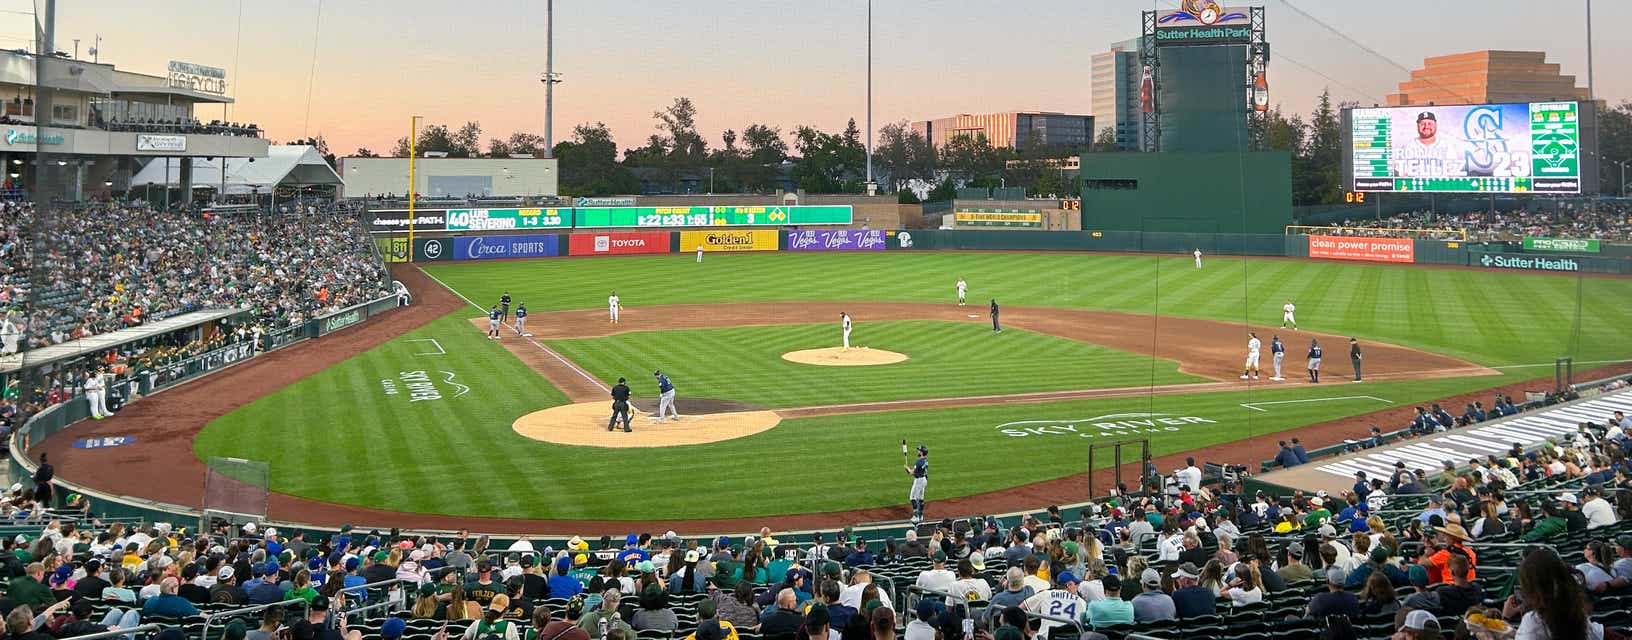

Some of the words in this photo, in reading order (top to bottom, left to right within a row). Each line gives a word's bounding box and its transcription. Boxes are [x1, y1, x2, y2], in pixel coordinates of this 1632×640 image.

[1157, 30, 1189, 39] Sutter
[1190, 29, 1224, 38] Health
[1225, 27, 1250, 37] Park
[1395, 159, 1468, 177] TELLEZ
[1493, 152, 1531, 177] 23
[400, 218, 418, 227] yor
[449, 212, 469, 227] 40
[469, 218, 516, 229] SEVERINO
[393, 242, 408, 253] 811
[612, 239, 646, 248] TOYOTA
[788, 231, 819, 249] Vegas
[821, 231, 852, 249] Vegas
[853, 231, 885, 249] Vegas
[1311, 239, 1336, 248] clean
[1338, 241, 1368, 251] power
[1371, 242, 1410, 252] promise
[426, 243, 439, 254] 42
[468, 237, 507, 259] Circa
[512, 242, 544, 254] SPORTS
[1494, 255, 1534, 268] Sutter
[1535, 257, 1578, 271] Health
[1000, 424, 1078, 438] SKY
[1092, 416, 1217, 431] RIVER
[1079, 426, 1180, 439] CASINO
[1049, 600, 1077, 619] 24
